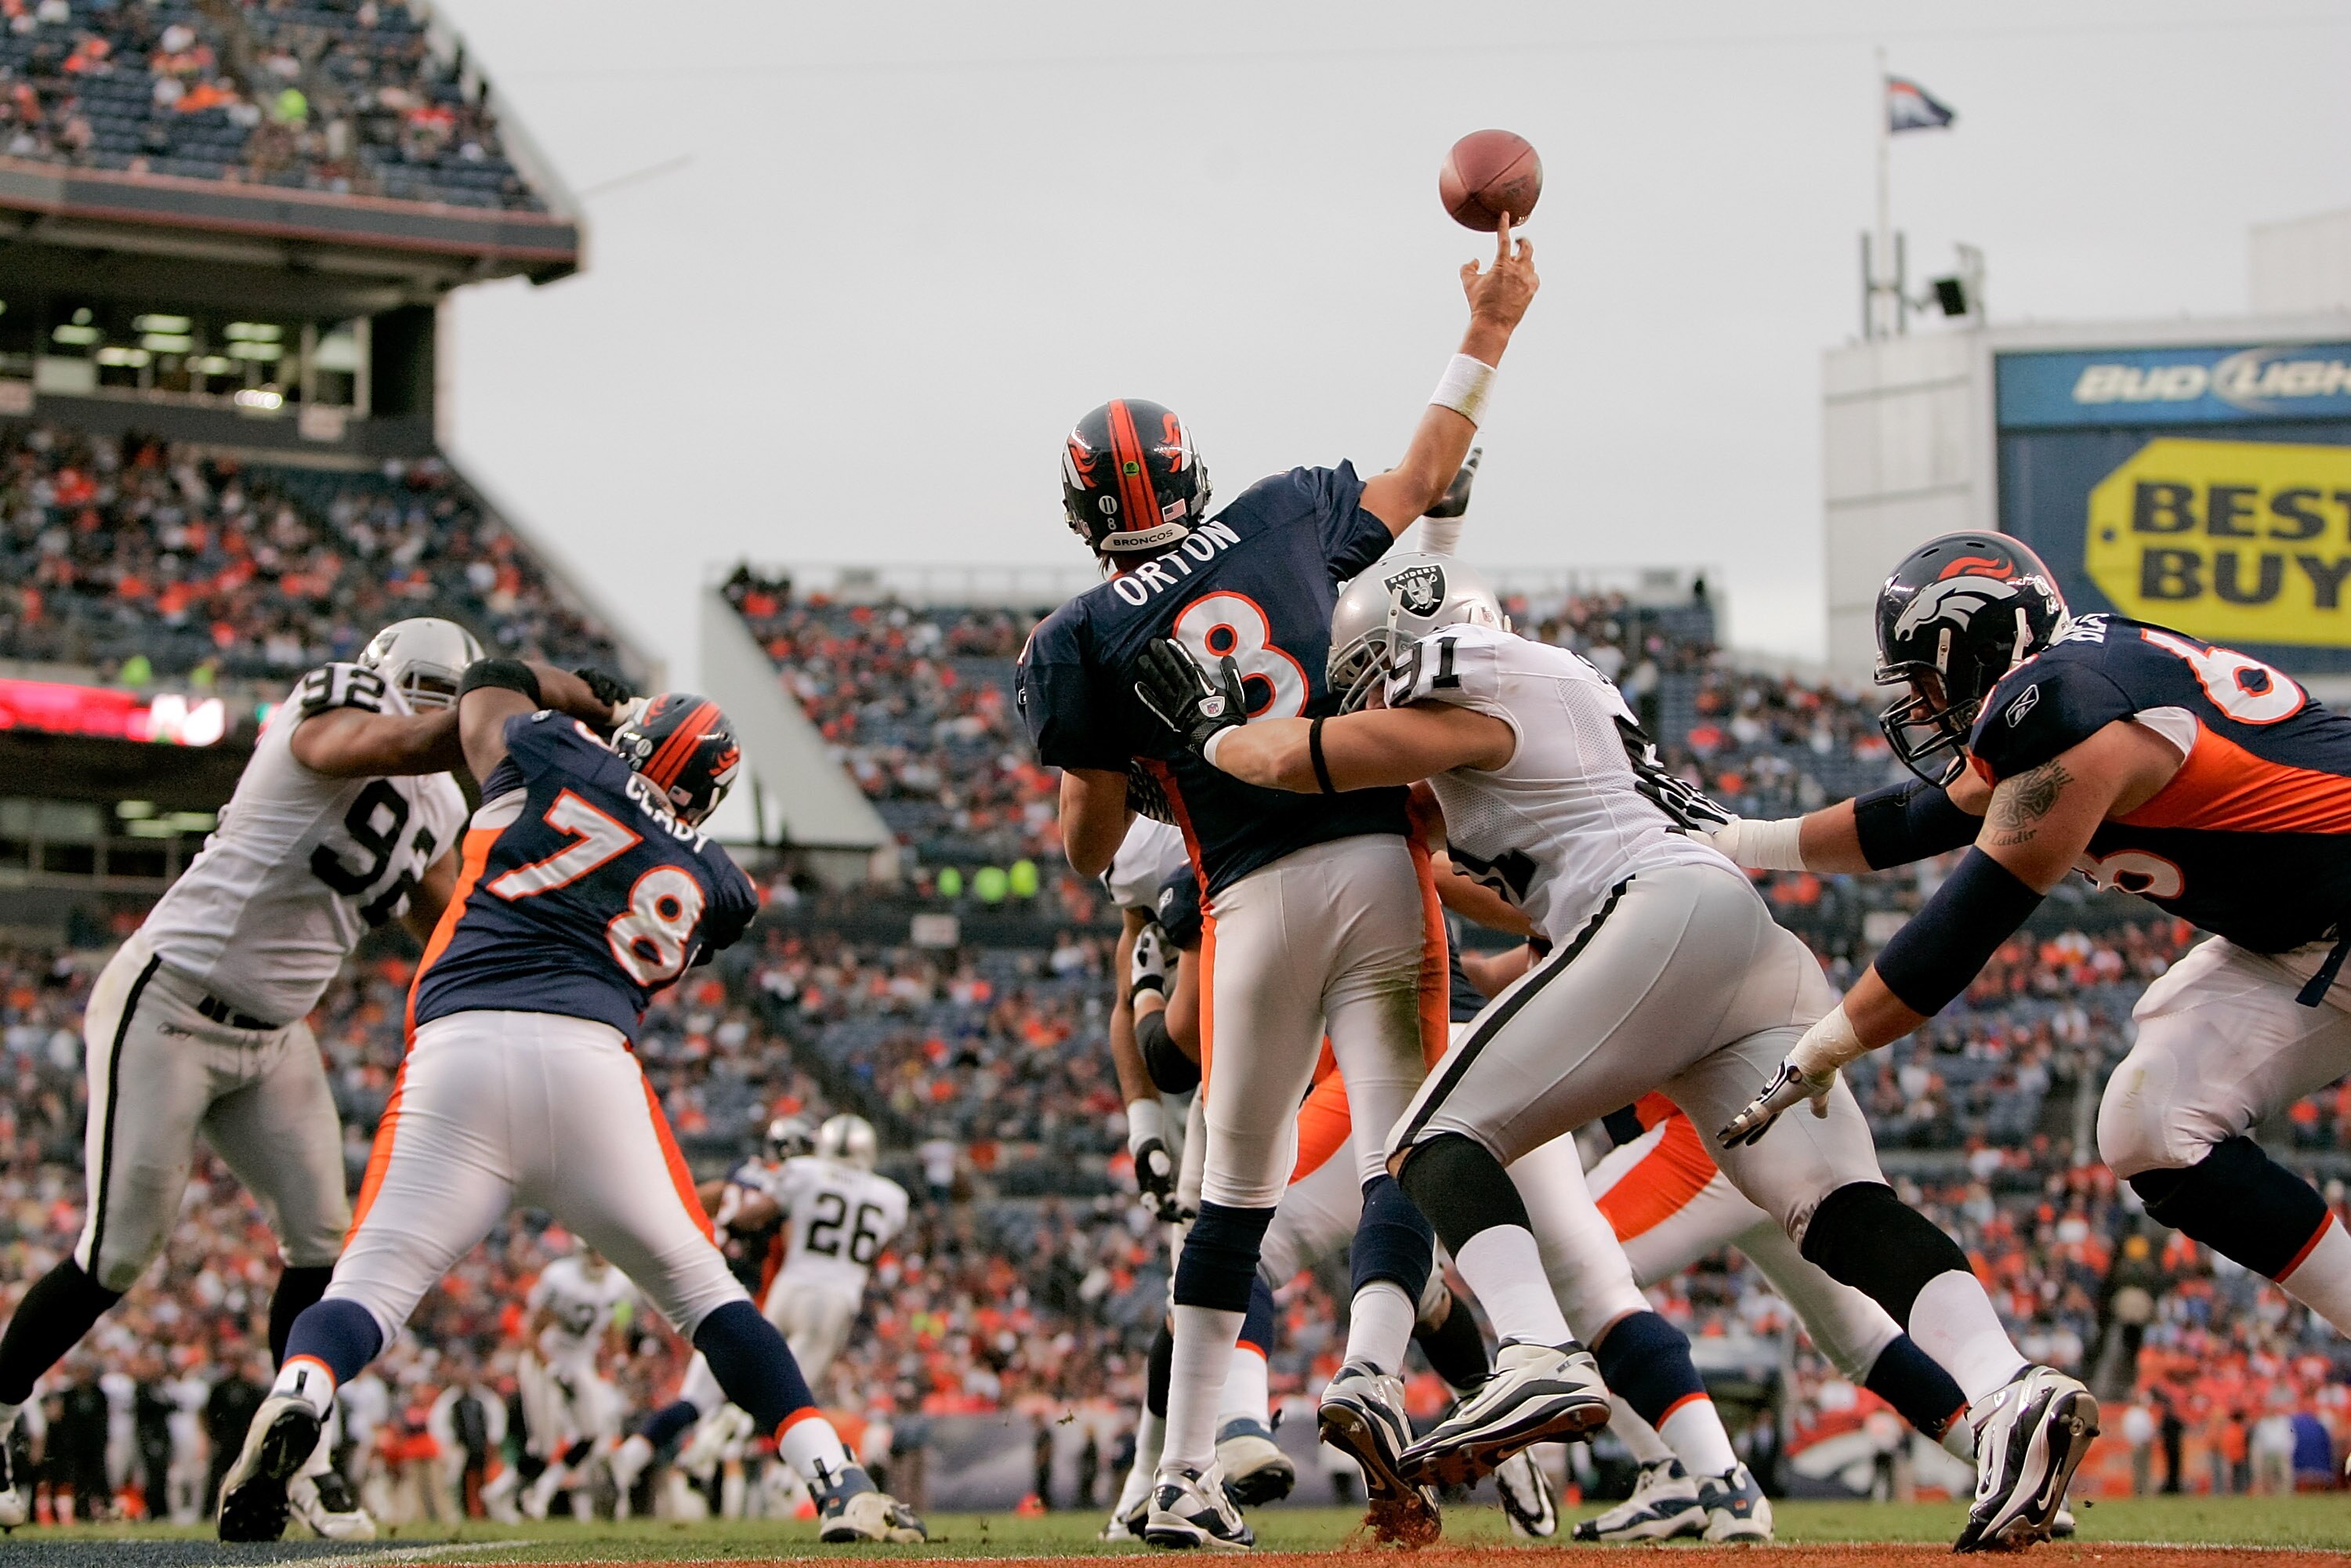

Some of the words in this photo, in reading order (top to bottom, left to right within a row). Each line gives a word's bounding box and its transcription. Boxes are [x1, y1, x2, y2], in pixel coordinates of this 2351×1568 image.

[2073, 364, 2208, 404] BUD
[1107, 517, 1117, 531] 8
[1113, 529, 1173, 547] BRONCOS
[1113, 520, 1241, 607] ORTON
[1389, 566, 1437, 585] RAIDERS
[2140, 549, 2351, 609] BUY
[1172, 590, 1310, 725] 8
[301, 665, 386, 713] 92
[625, 773, 710, 854] CLADY
[485, 786, 705, 988] 78
[806, 1192, 883, 1266] 26
